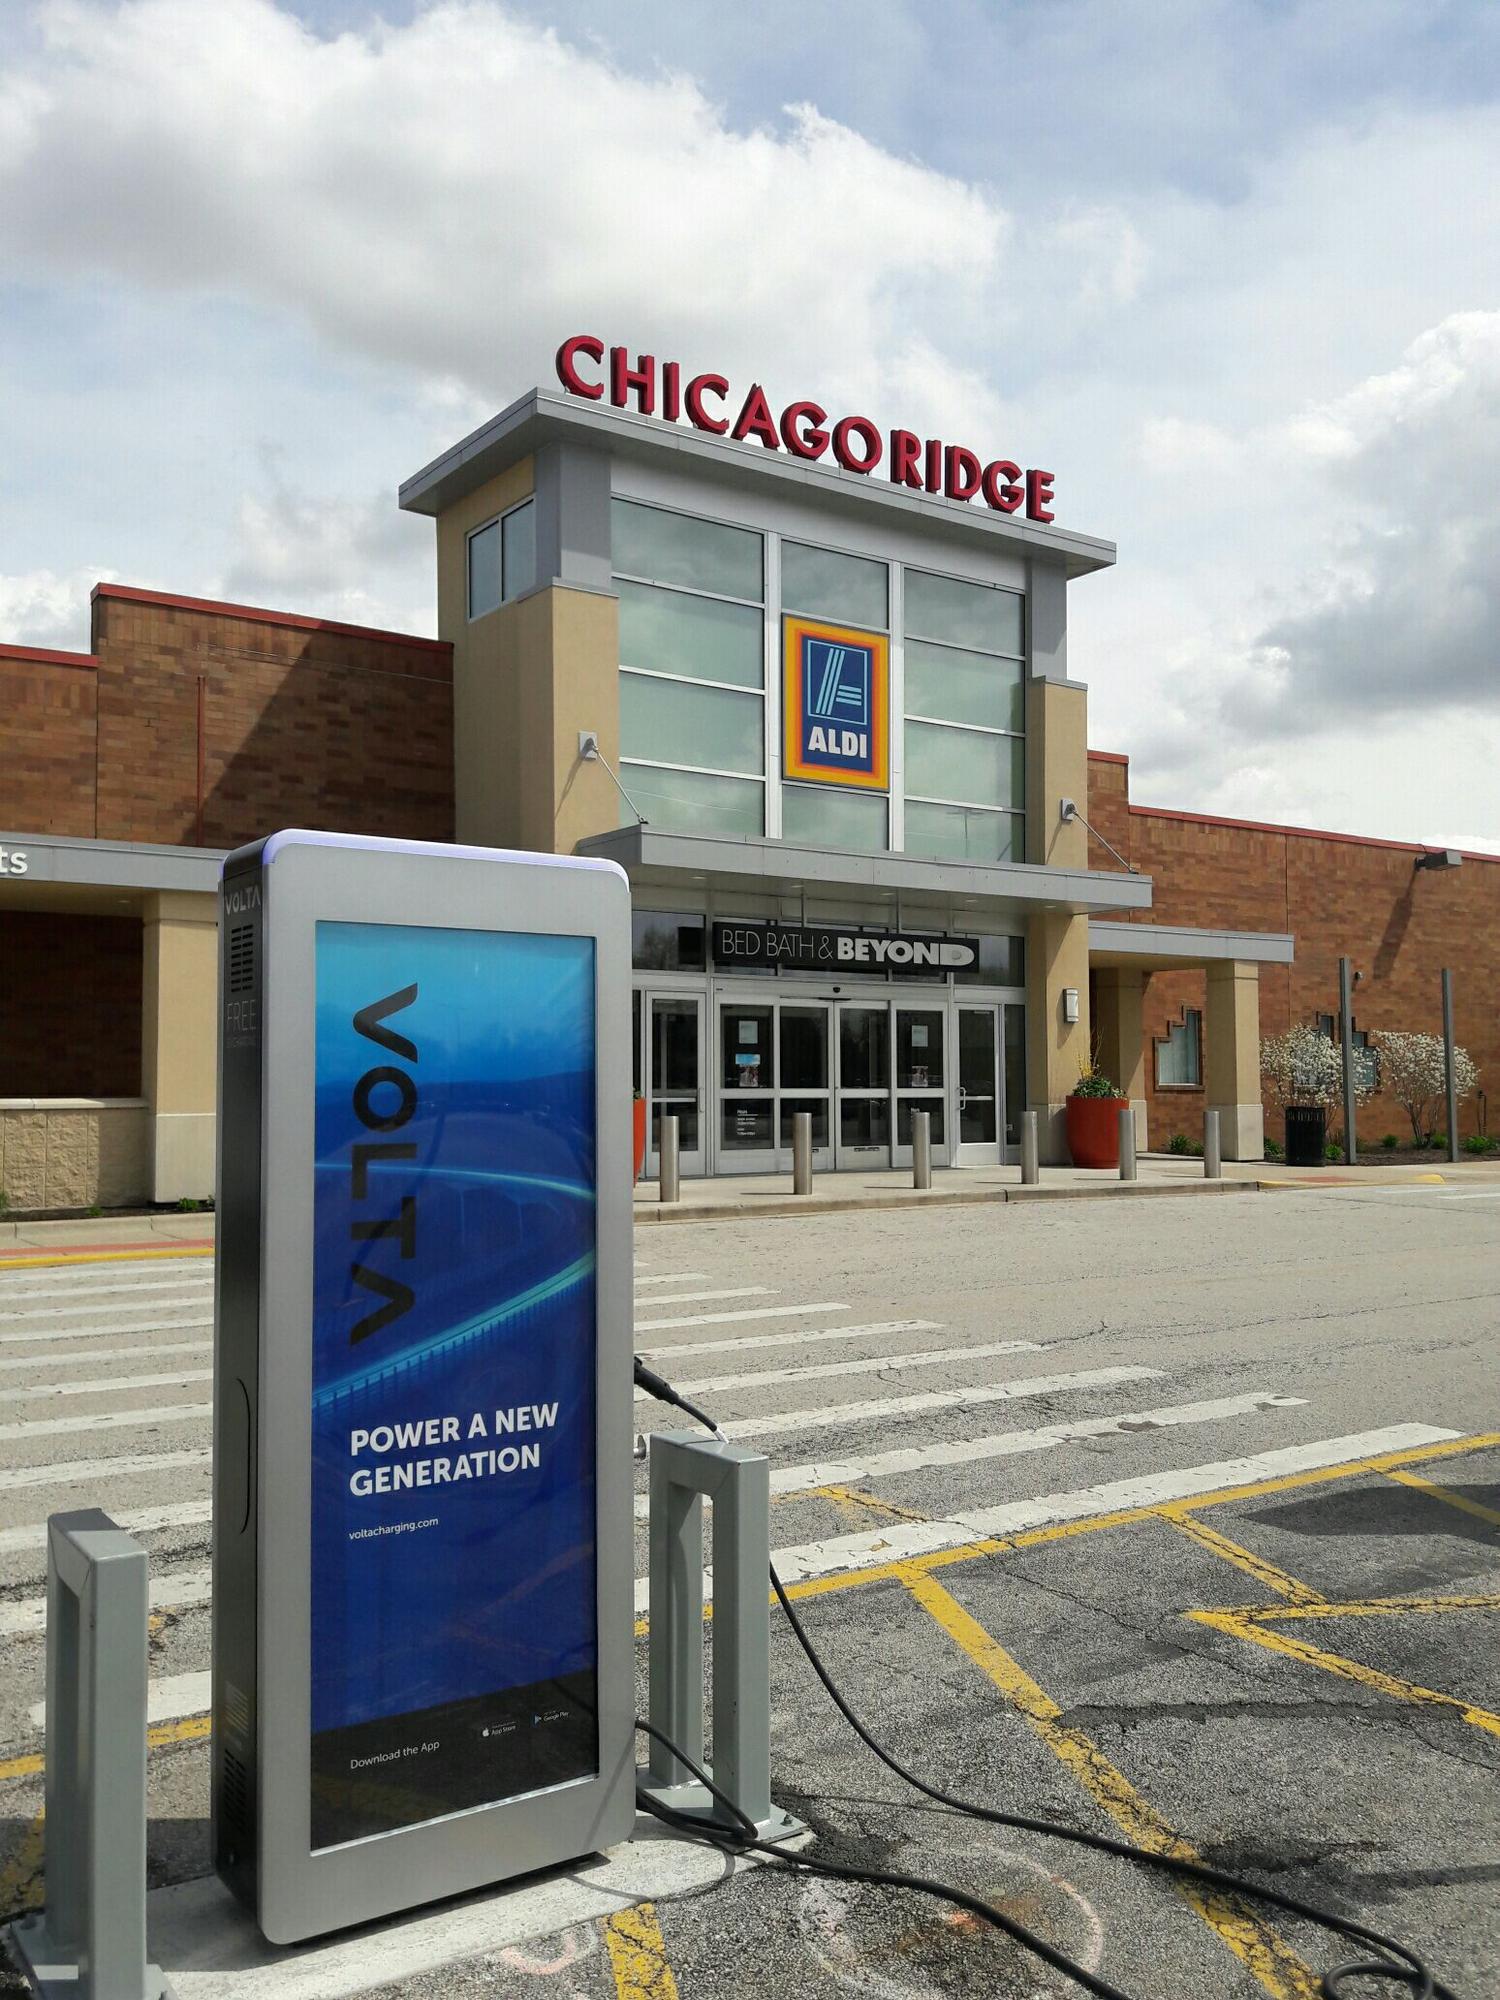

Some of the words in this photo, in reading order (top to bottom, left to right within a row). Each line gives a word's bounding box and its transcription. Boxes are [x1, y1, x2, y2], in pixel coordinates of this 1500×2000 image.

[555, 334, 883, 474] CHICAGO
[889, 428, 1055, 523] RIDGE
[807, 725, 868, 759] ALDI
[224, 884, 261, 915] VOLTA
[722, 929, 761, 956] BED
[766, 932, 814, 959] BATH
[817, 935, 834, 960] &
[837, 937, 975, 967] BEYOND
[226, 999, 257, 1032] FREE
[350, 981, 418, 1346] VOLTA
[351, 1416, 461, 1457] POWER
[467, 1412, 488, 1439] A
[495, 1402, 559, 1435] NEW
[349, 1443, 541, 1497] GENERATION
[349, 1517, 439, 1540] voltacharging.com
[350, 1749, 401, 1769] Download
[403, 1745, 419, 1756] the
[420, 1740, 441, 1755] App
